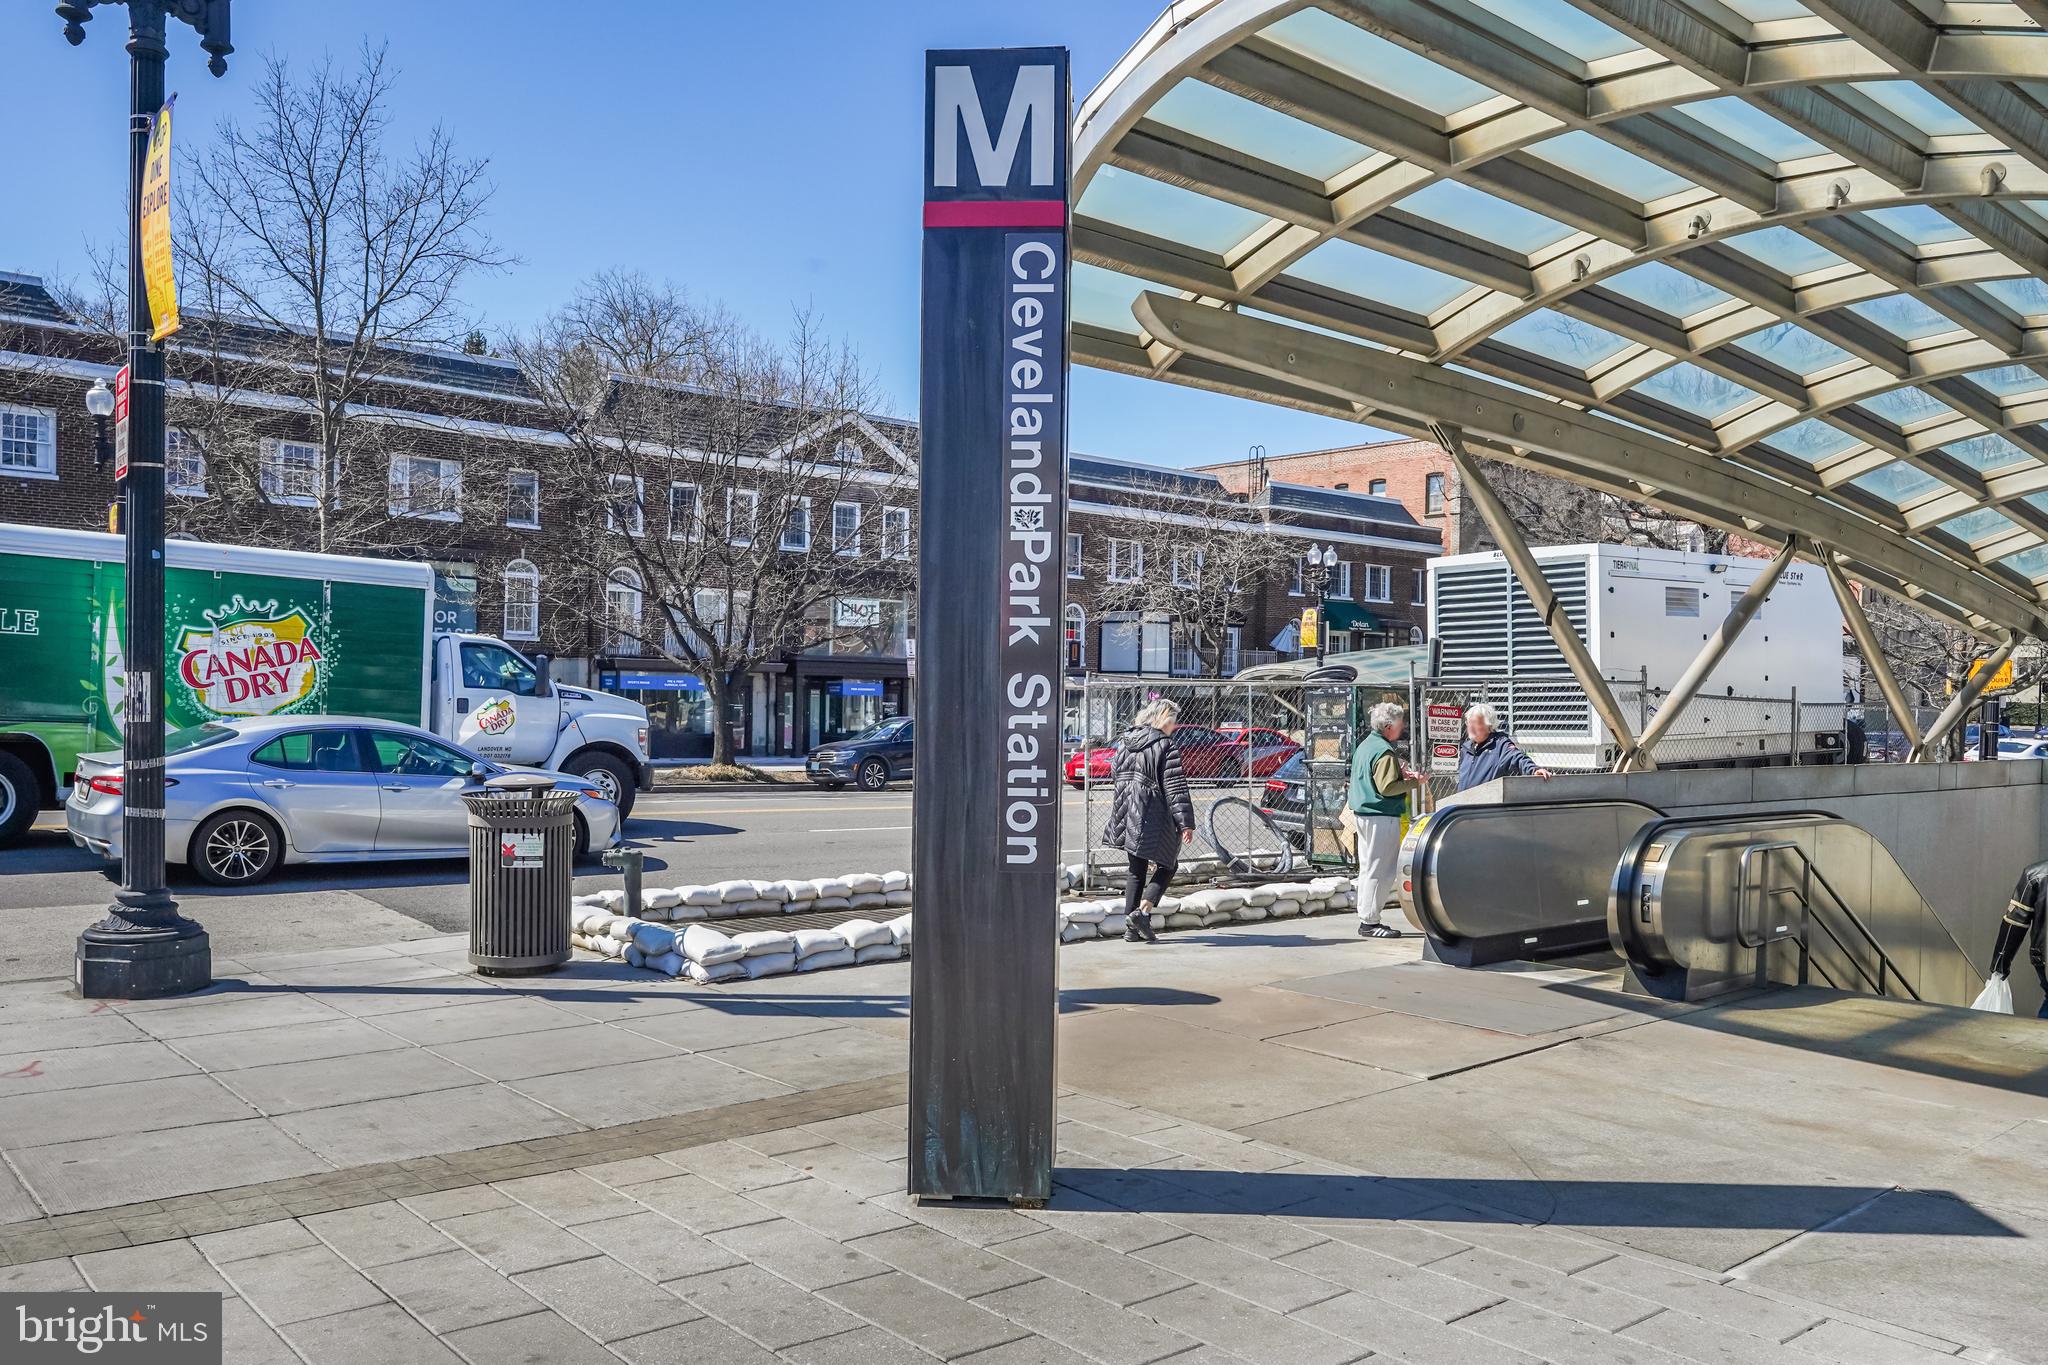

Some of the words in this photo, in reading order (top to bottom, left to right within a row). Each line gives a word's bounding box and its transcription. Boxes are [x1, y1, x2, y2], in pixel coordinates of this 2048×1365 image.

[934, 65, 1055, 187] M
[143, 181, 168, 219] EXPLORE
[1009, 241, 1056, 503] Cleveland
[1008, 530, 1052, 647] Park
[434, 610, 457, 624] OR
[220, 634, 248, 646] SINCE
[181, 637, 321, 689] CANADA
[224, 667, 291, 703] DRY
[479, 706, 514, 730] CANADA
[490, 717, 508, 732] DRY
[1431, 708, 1459, 716] WARNING
[1430, 725, 1459, 733] EMERGENCY
[1436, 747, 1455, 755] DANGER
[1005, 672, 1052, 865] Station
